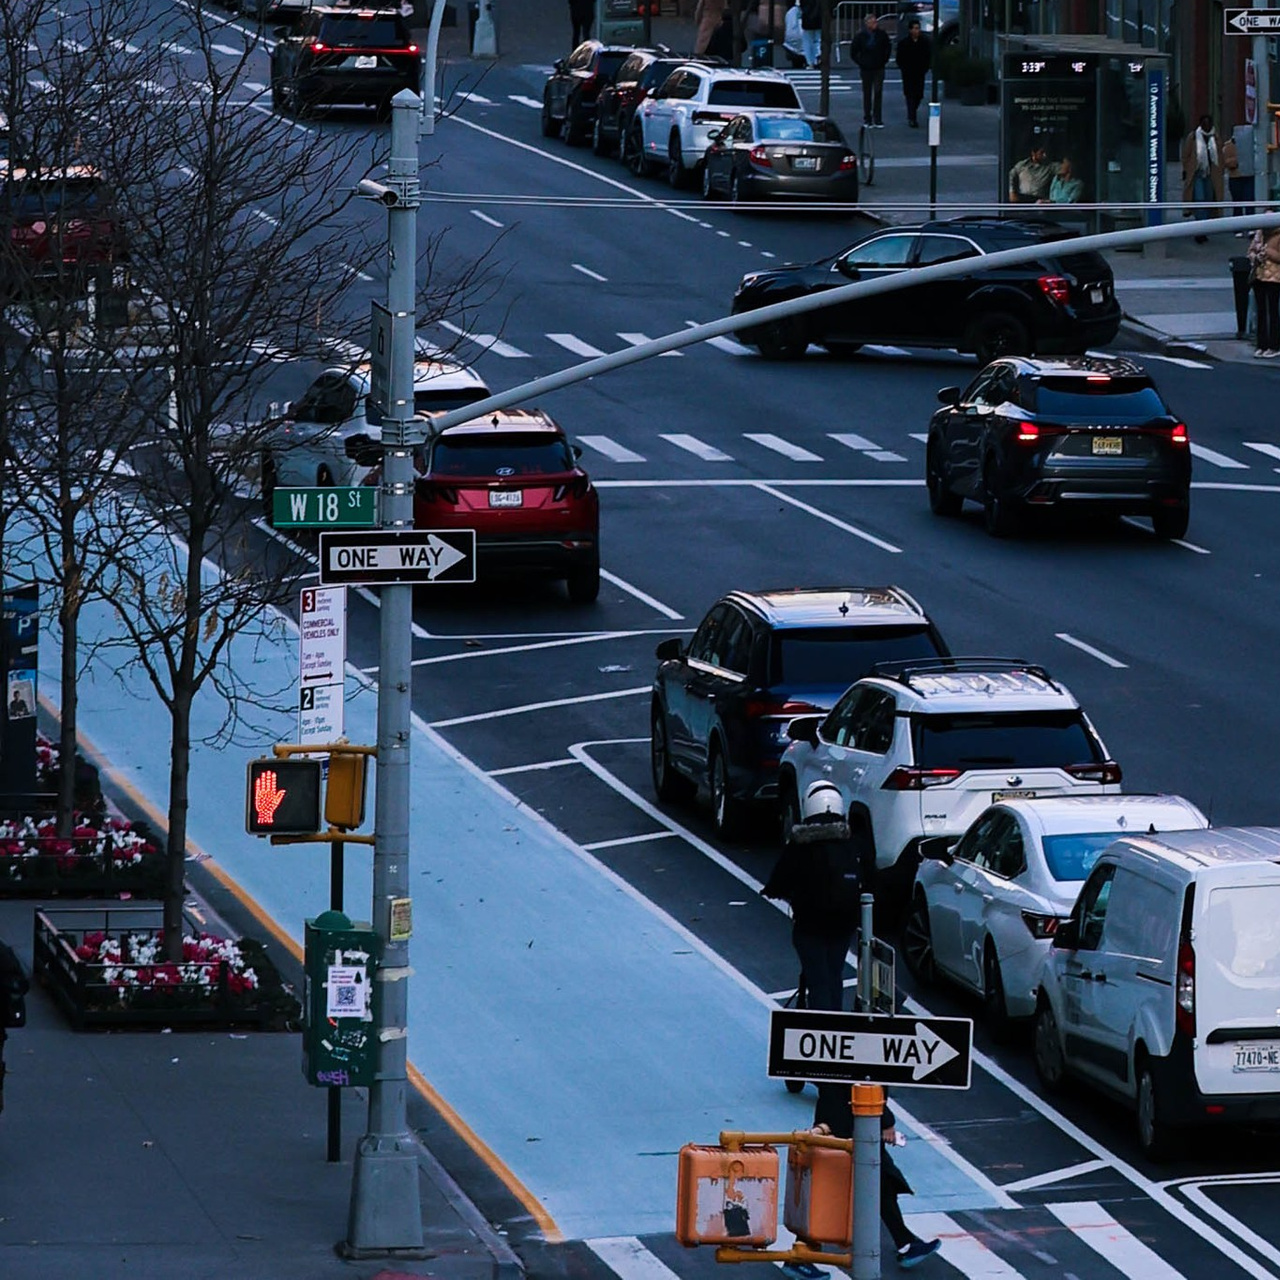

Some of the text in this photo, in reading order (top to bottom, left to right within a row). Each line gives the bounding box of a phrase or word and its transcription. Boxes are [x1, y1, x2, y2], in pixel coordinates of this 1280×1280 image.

[1239, 17, 1259, 26] ONE
[1150, 95, 1158, 128] Avenue
[1150, 138, 1158, 161] West
[290, 490, 361, 522] W 18 St
[337, 547, 444, 567] ONE WAY
[304, 592, 313, 611] 3
[303, 618, 335, 630] COMMERCIAL
[303, 627, 340, 640] VEHICLES ONLY
[303, 689, 311, 708] 2
[799, 1033, 940, 1065] ONE WAY
